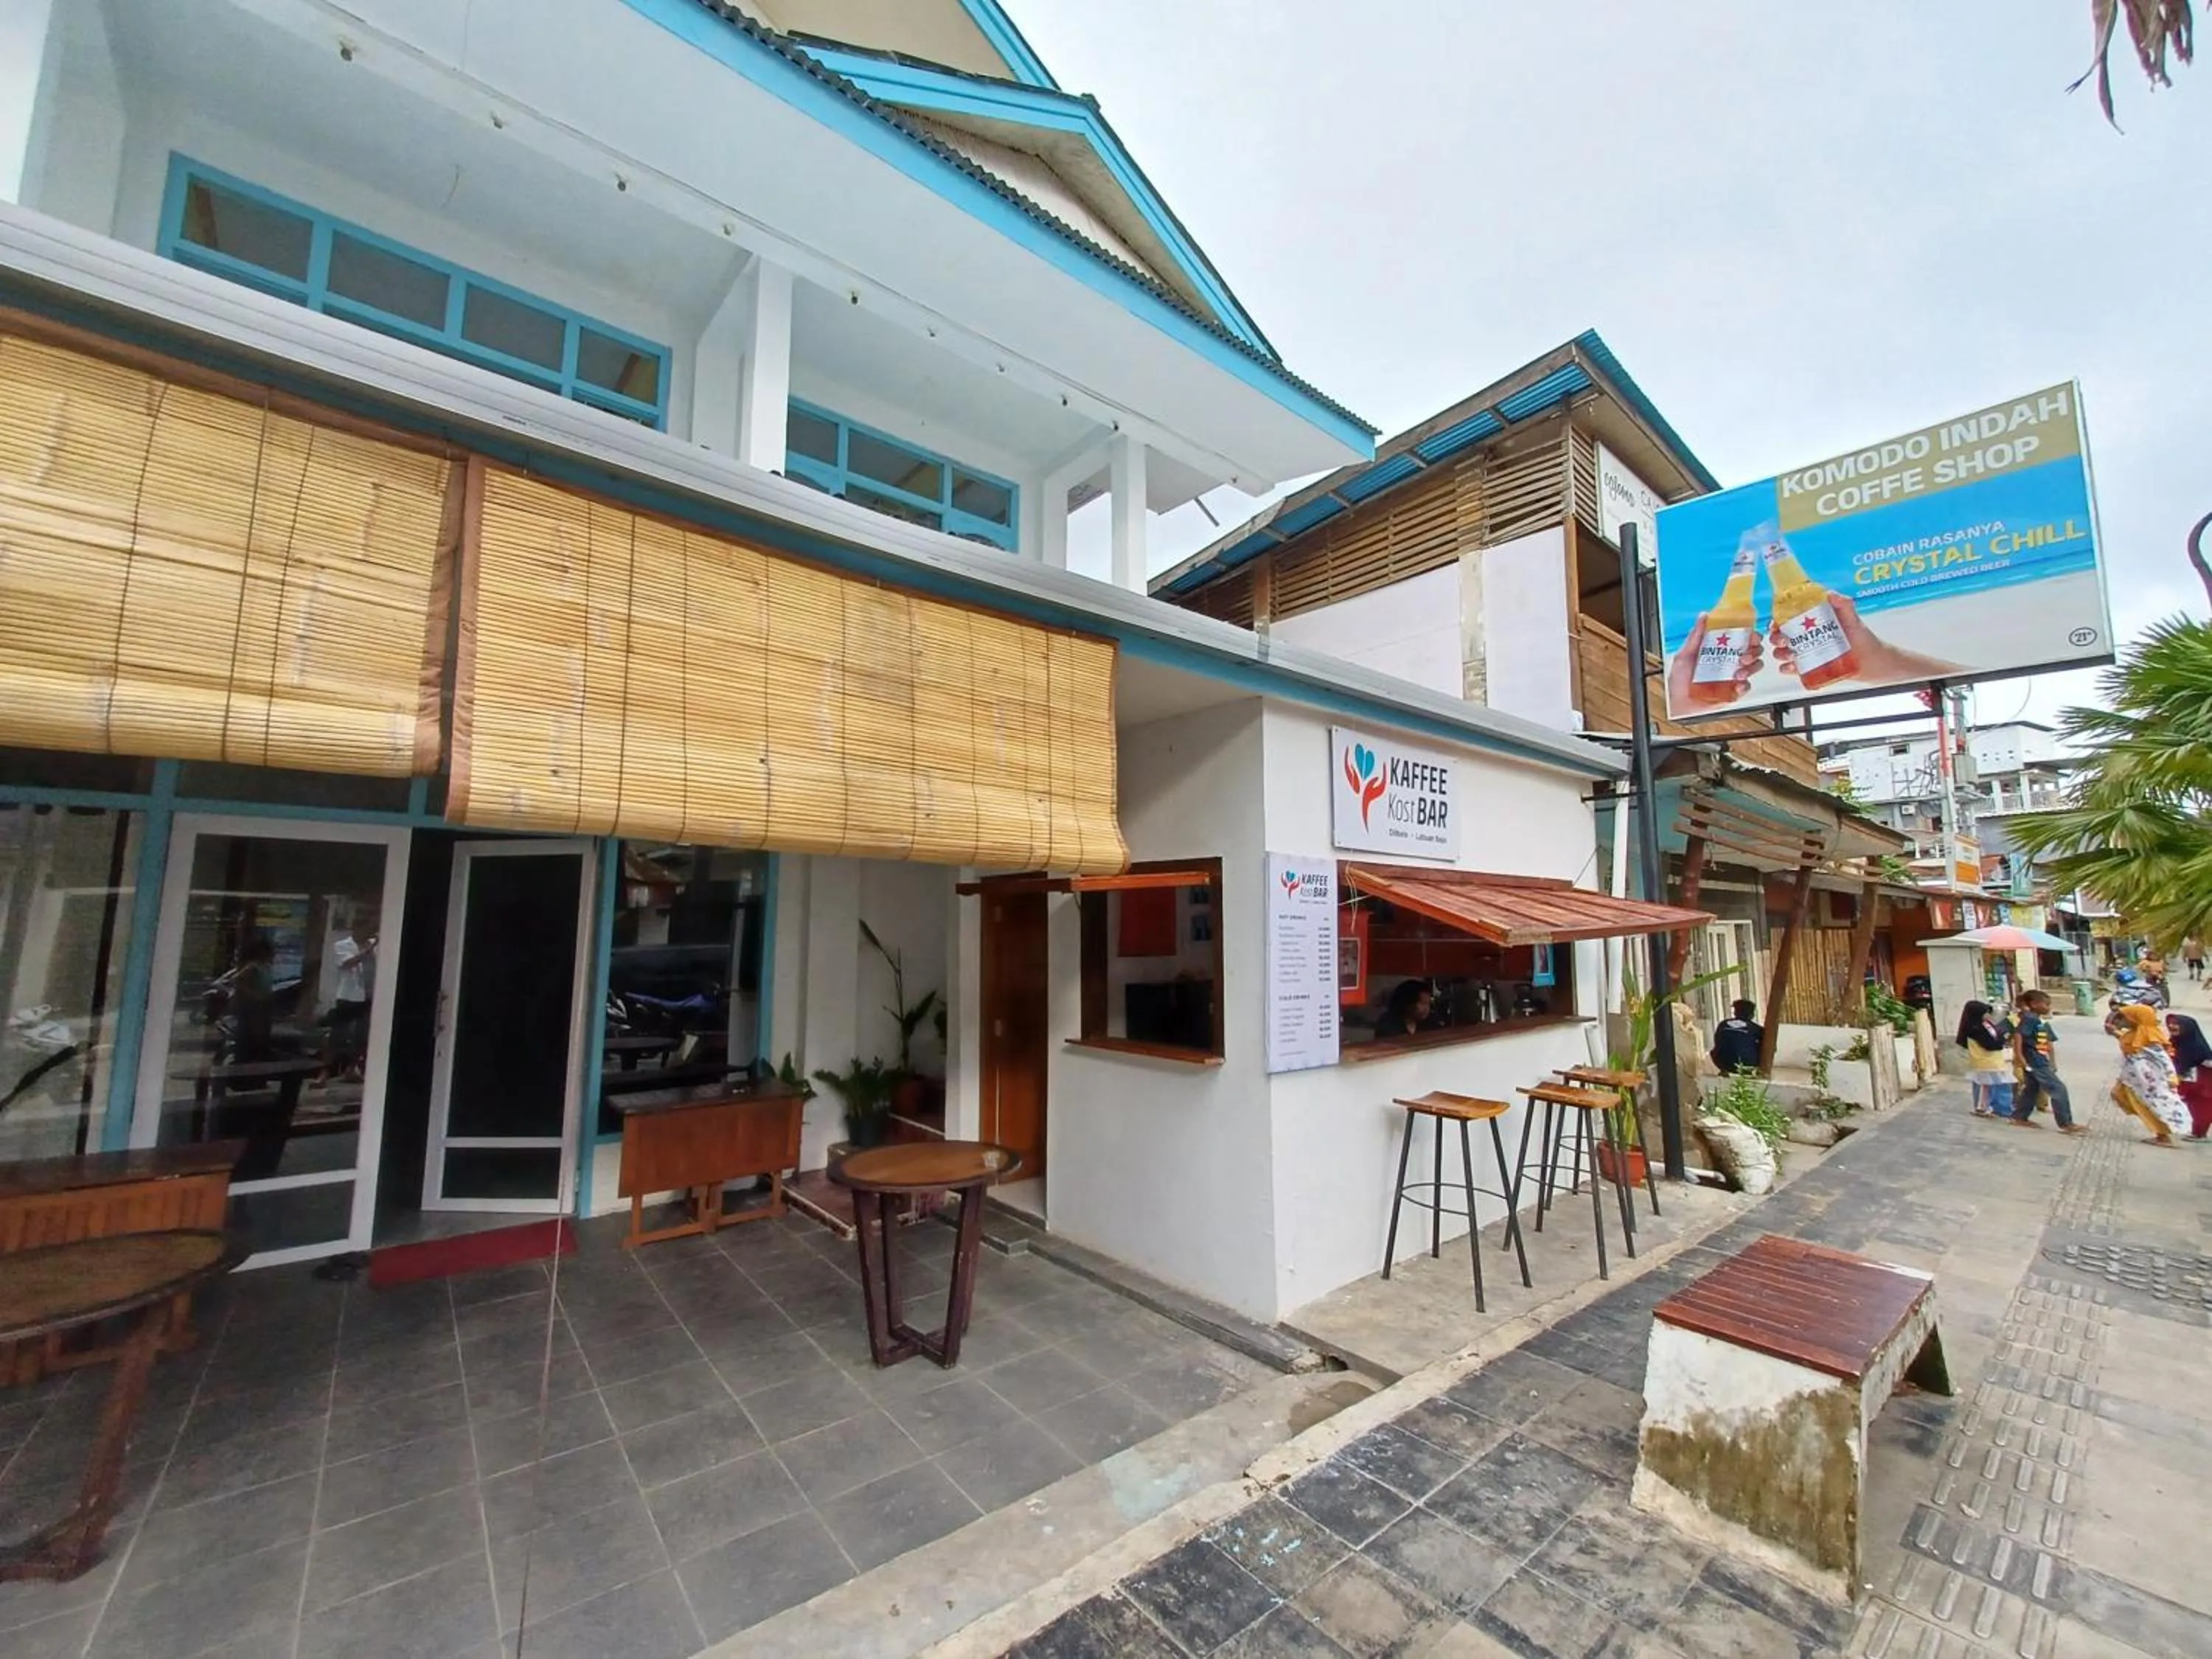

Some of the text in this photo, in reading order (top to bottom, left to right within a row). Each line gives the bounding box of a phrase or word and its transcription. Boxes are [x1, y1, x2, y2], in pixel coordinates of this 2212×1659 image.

[1781, 390, 2069, 498] KOMODO INDAH
[1816, 436, 2039, 516] COFFE SHOP
[1853, 520, 2006, 566] COBAIN RASANYA
[1854, 518, 2086, 585] CRYSTAL CHILL
[1700, 647, 1742, 657] BINTANG
[1790, 620, 1839, 647] BINTANG
[1390, 757, 1448, 796] KAFFEE
[1388, 793, 1448, 829] Kost BAR
[1301, 873, 1328, 886] KAFFEE
[1313, 887, 1328, 897] BAR
